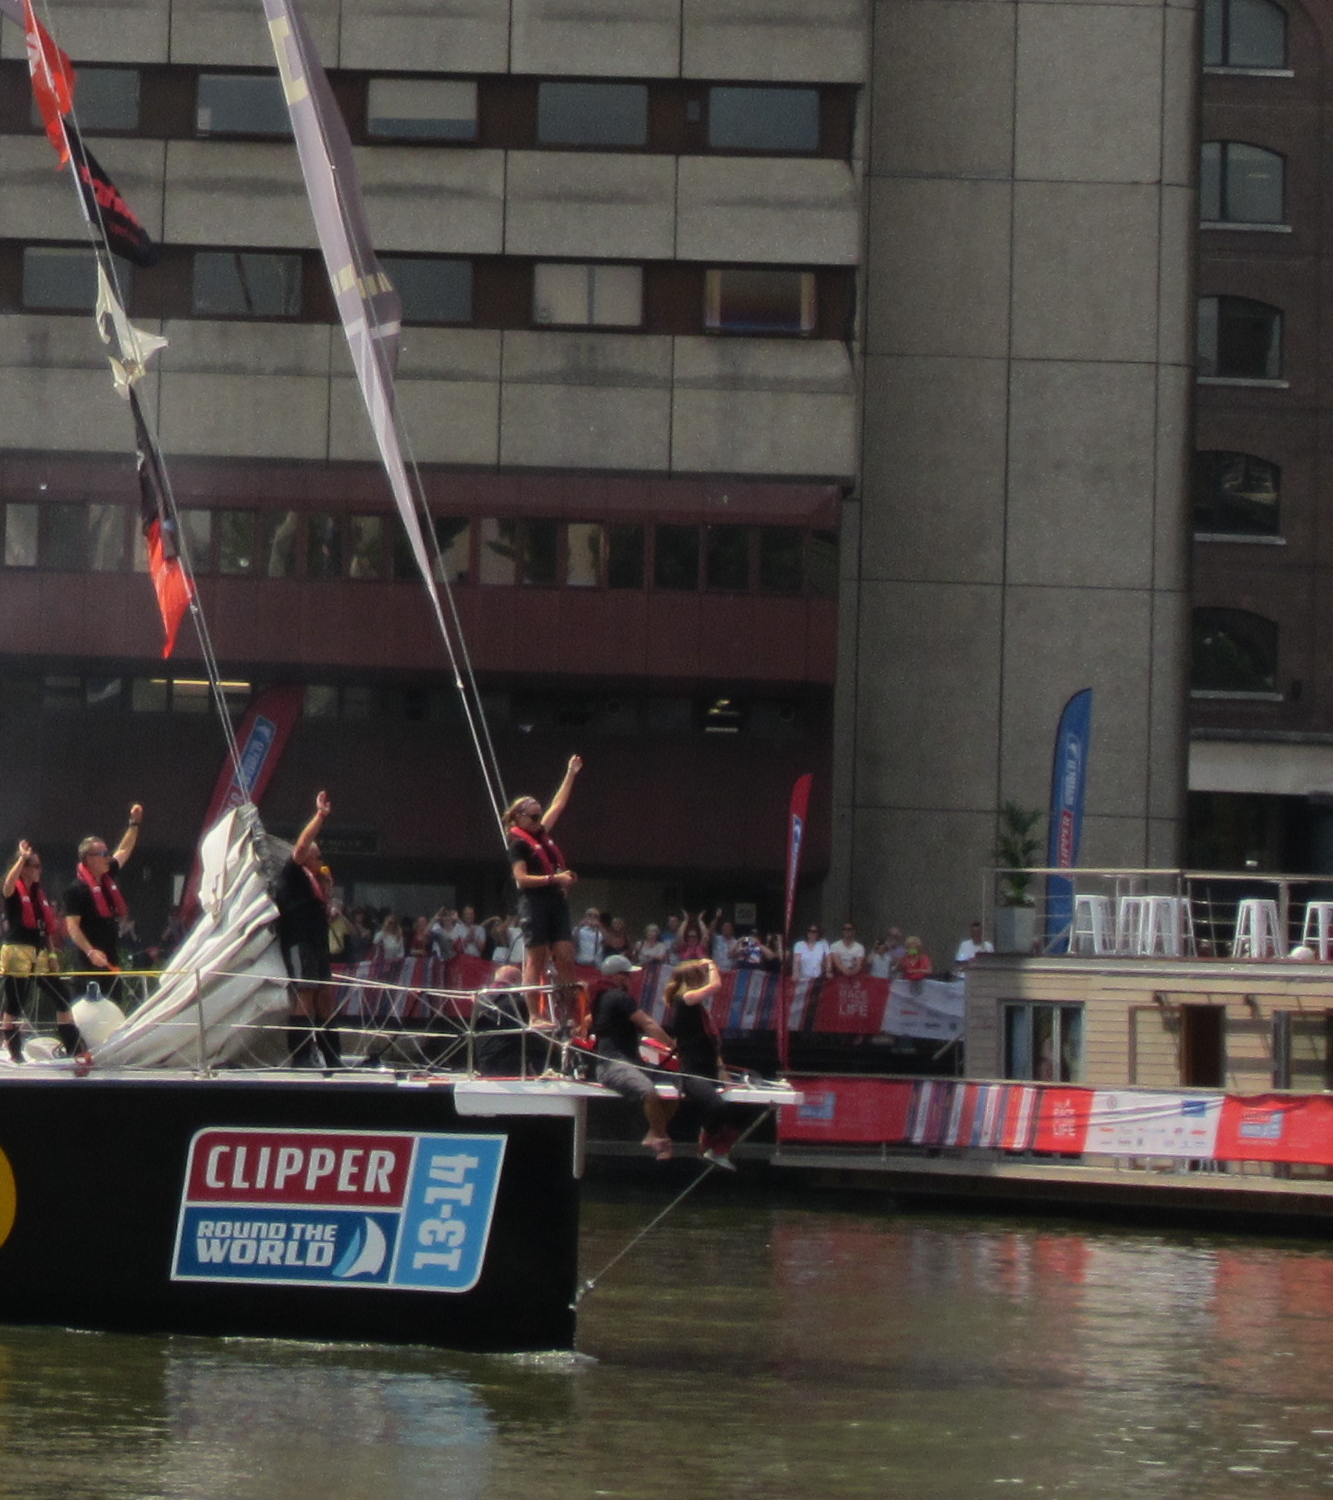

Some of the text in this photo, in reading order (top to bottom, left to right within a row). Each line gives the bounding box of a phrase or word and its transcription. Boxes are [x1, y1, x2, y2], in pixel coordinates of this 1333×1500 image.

[839, 1004, 868, 1017] LIFE
[205, 1145, 396, 1194] CLIPPER
[412, 1153, 480, 1272] 13-14
[197, 1221, 339, 1241] ROUND THE
[196, 1238, 335, 1267] WORLD
